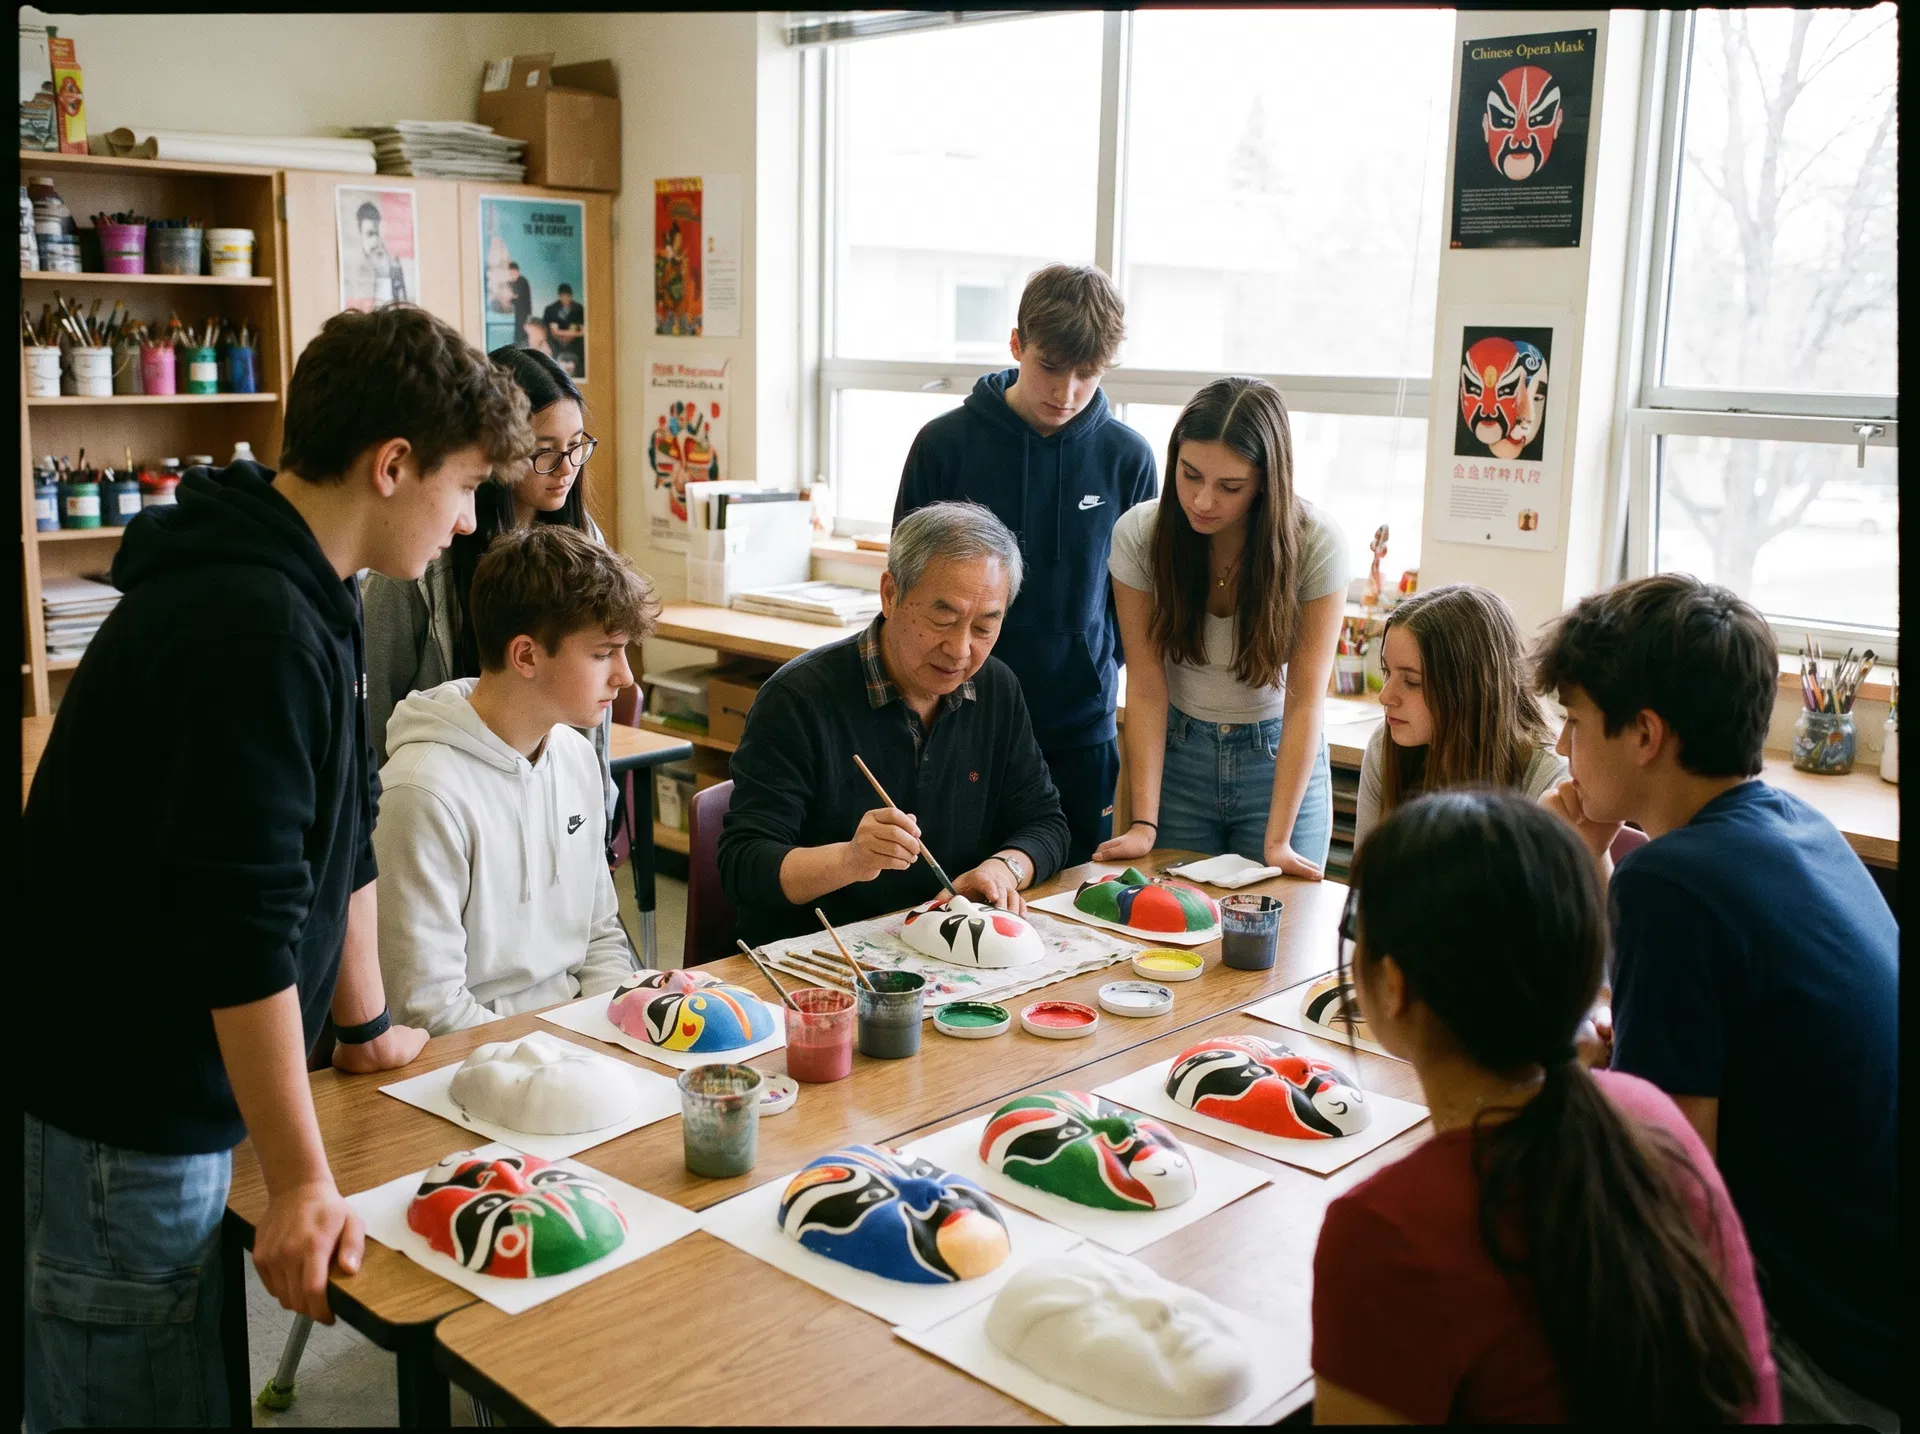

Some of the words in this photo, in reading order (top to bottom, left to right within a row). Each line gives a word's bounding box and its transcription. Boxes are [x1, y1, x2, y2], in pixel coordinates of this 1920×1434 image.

[1471, 46, 1514, 60] Chinese
[1516, 44, 1551, 59] Opera
[1554, 39, 1585, 53] Mask
